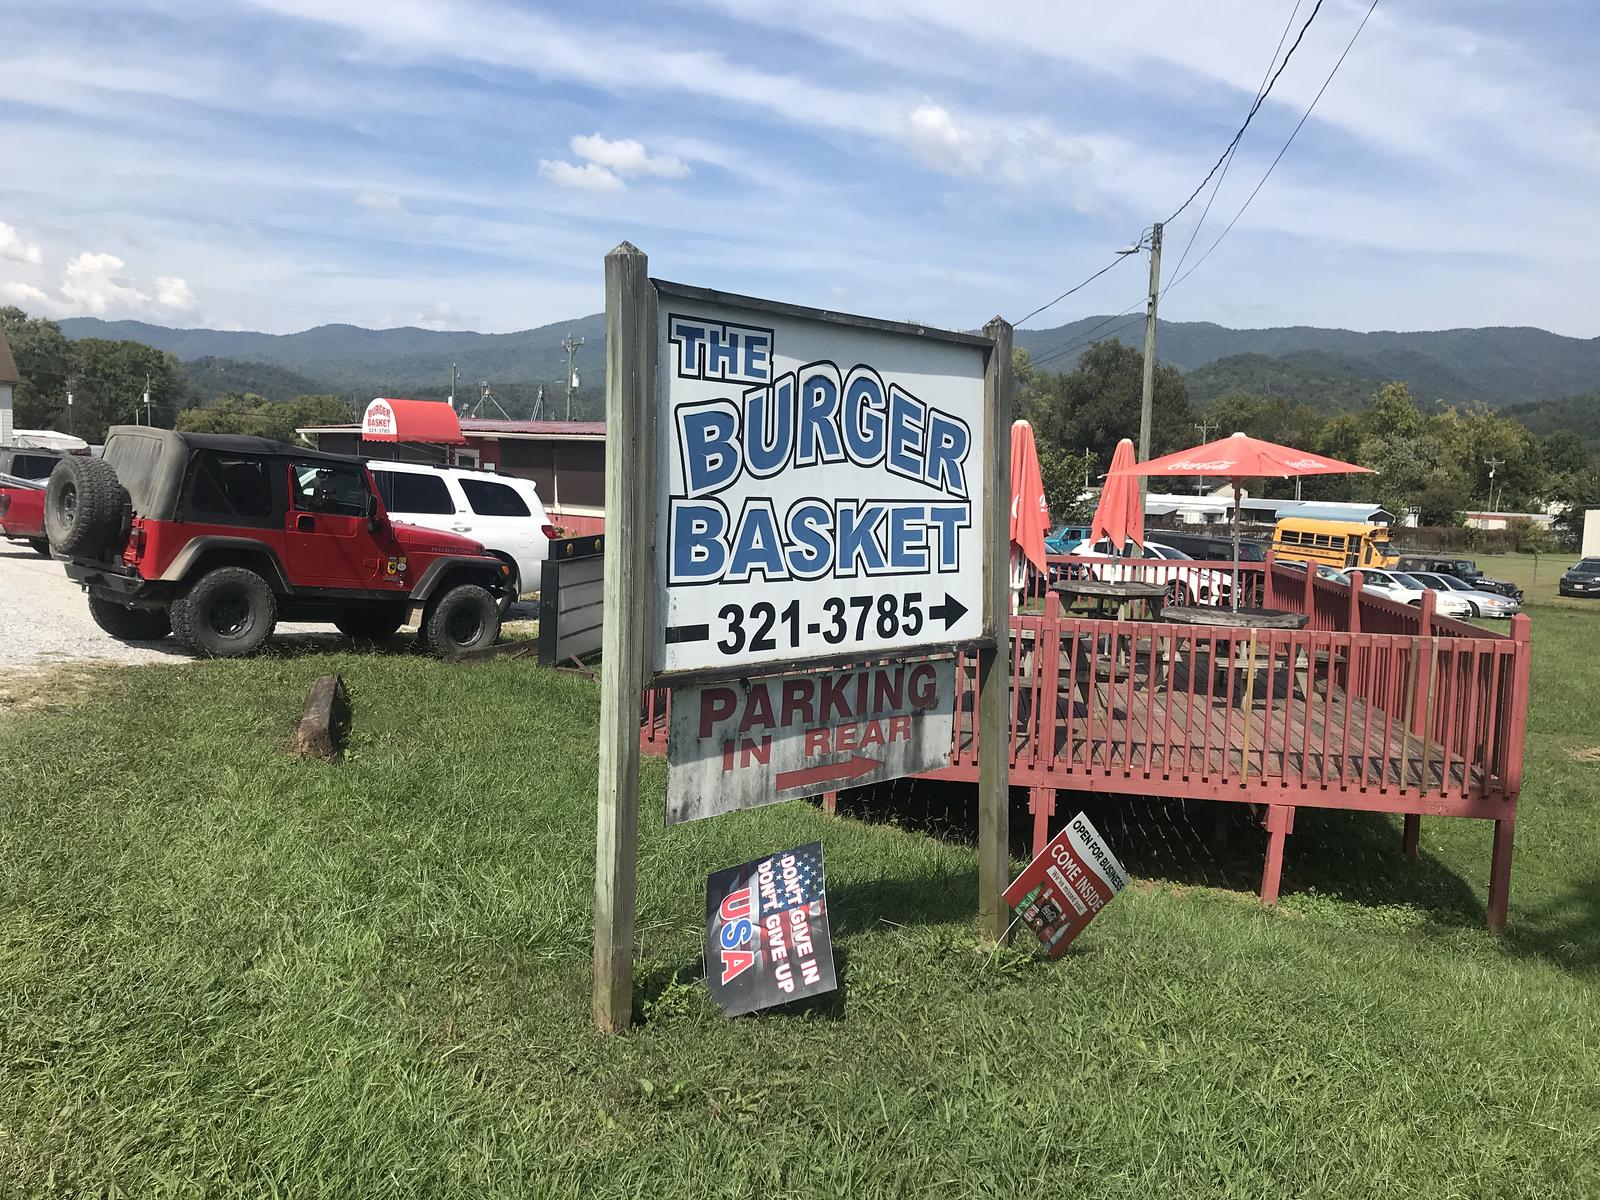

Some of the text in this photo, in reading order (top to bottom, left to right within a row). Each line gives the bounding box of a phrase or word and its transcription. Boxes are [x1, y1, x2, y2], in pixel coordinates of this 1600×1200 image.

[668, 313, 774, 384] THE
[367, 419, 390, 427] BASKET
[368, 405, 390, 418] BURGER
[674, 360, 971, 500] BURGER
[666, 496, 971, 587] BASKET
[717, 592, 923, 655] 321-3785
[698, 664, 938, 739] PARKING
[722, 715, 912, 773] IN REAR
[1051, 844, 1105, 913] COME INSIDE
[1073, 820, 1125, 892] OPEN FOR BUSINESS
[719, 887, 755, 987] USA
[765, 914, 788, 962] GIVE
[790, 909, 814, 958] GIVE
[775, 962, 795, 994] UP
[800, 958, 821, 986] IN
